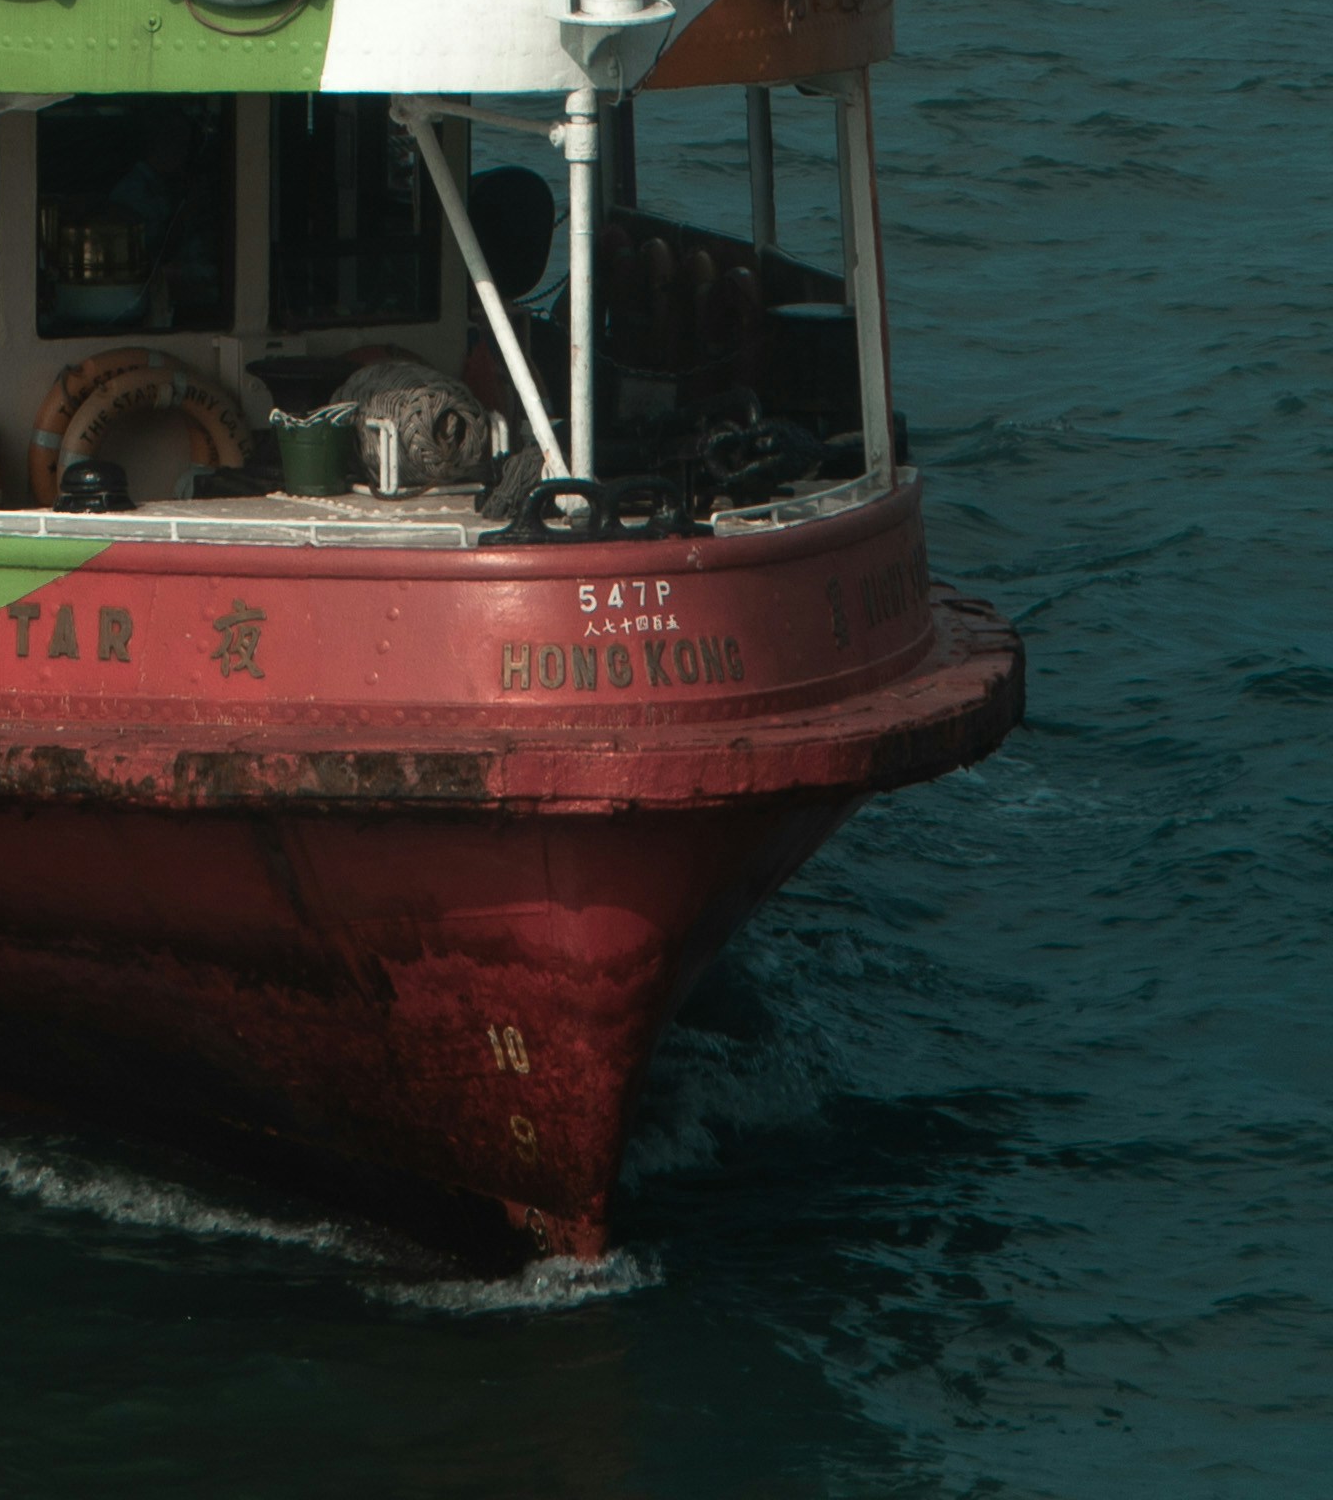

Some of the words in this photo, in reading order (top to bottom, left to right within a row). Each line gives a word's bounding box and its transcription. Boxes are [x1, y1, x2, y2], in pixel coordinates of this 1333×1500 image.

[80, 411, 111, 445] THE
[211, 598, 268, 680] 夜
[500, 641, 633, 693] HONG
[642, 635, 745, 688] KONG
[486, 1023, 531, 1075] 10
[509, 1114, 538, 1164] 9
